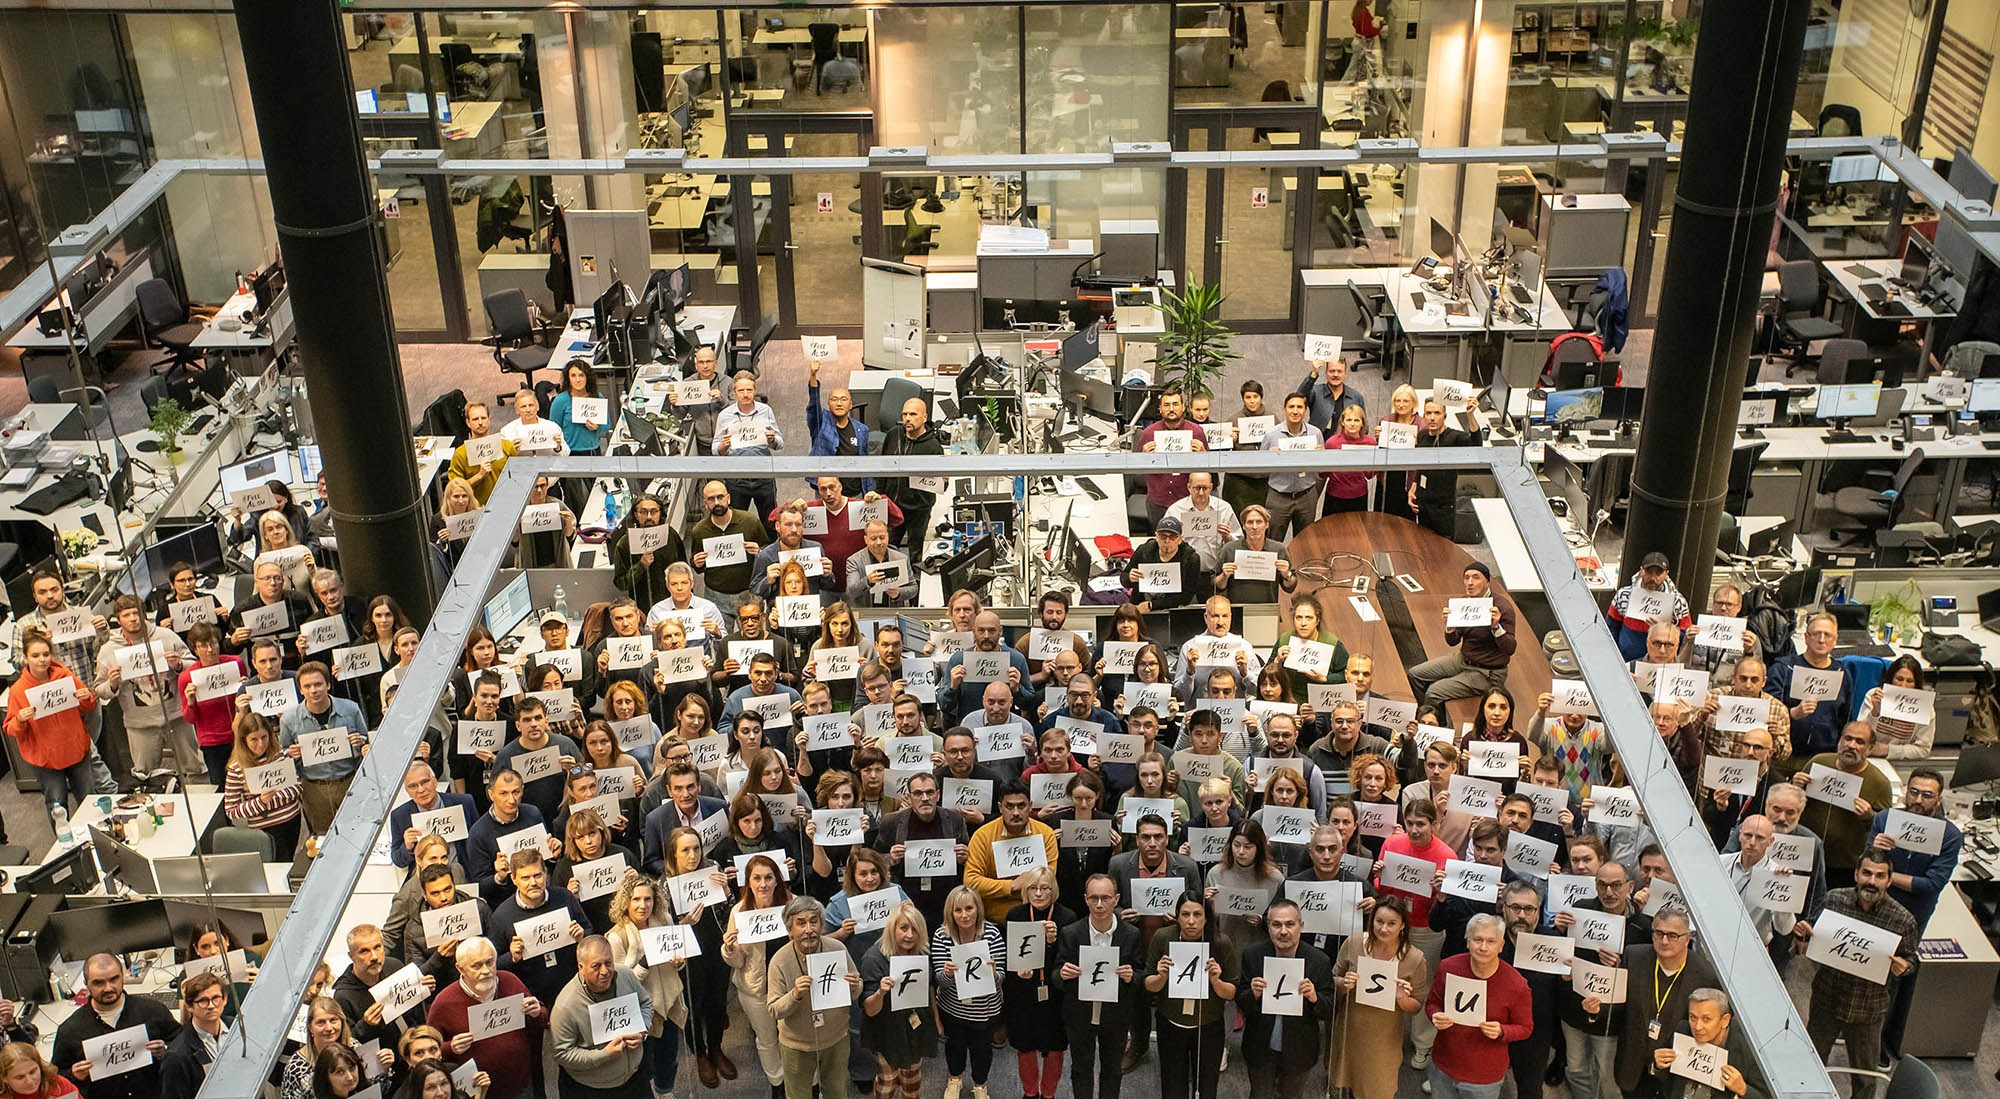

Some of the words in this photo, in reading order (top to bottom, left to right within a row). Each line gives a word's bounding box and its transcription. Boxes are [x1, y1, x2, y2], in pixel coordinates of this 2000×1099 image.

[1512, 853, 1539, 866] ALSU
[1771, 851, 1800, 860] ALSU
[1457, 880, 1485, 892] ALSU
[1301, 901, 1328, 912] ALSU
[1018, 935, 1036, 958] E
[1829, 942, 1870, 965] ALSU
[818, 962, 837, 995] #
[966, 957, 982, 982] R
[1090, 962, 1109, 986] E
[1177, 956, 1200, 984] A
[898, 969, 923, 996] F
[1273, 974, 1292, 1000] L
[1365, 974, 1387, 993] S
[1455, 991, 1480, 1013] U
[106, 1050, 135, 1067] ALSU
